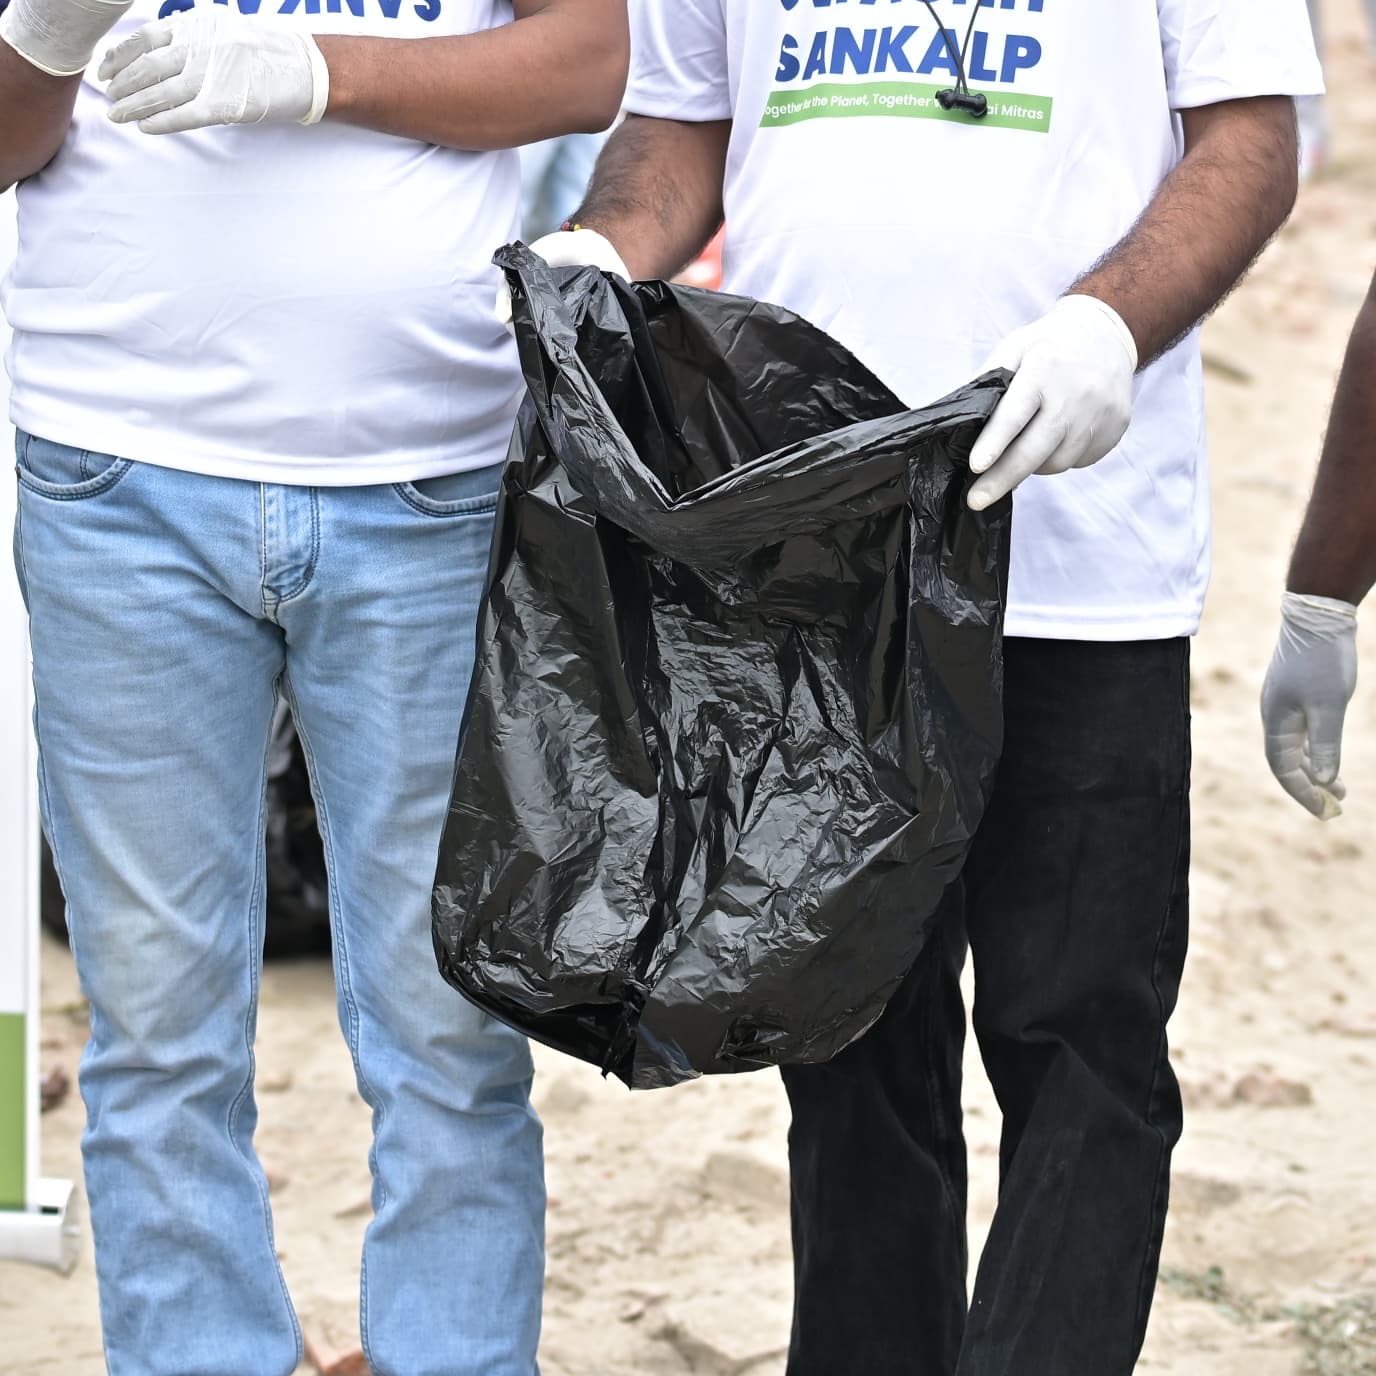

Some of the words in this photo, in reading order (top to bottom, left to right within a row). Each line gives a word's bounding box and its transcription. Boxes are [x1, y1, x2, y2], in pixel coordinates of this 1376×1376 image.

[774, 25, 1042, 83] SANKALP
[830, 94, 869, 107] Planet,
[872, 93, 931, 108] Together
[1000, 104, 1044, 120] Mitras
